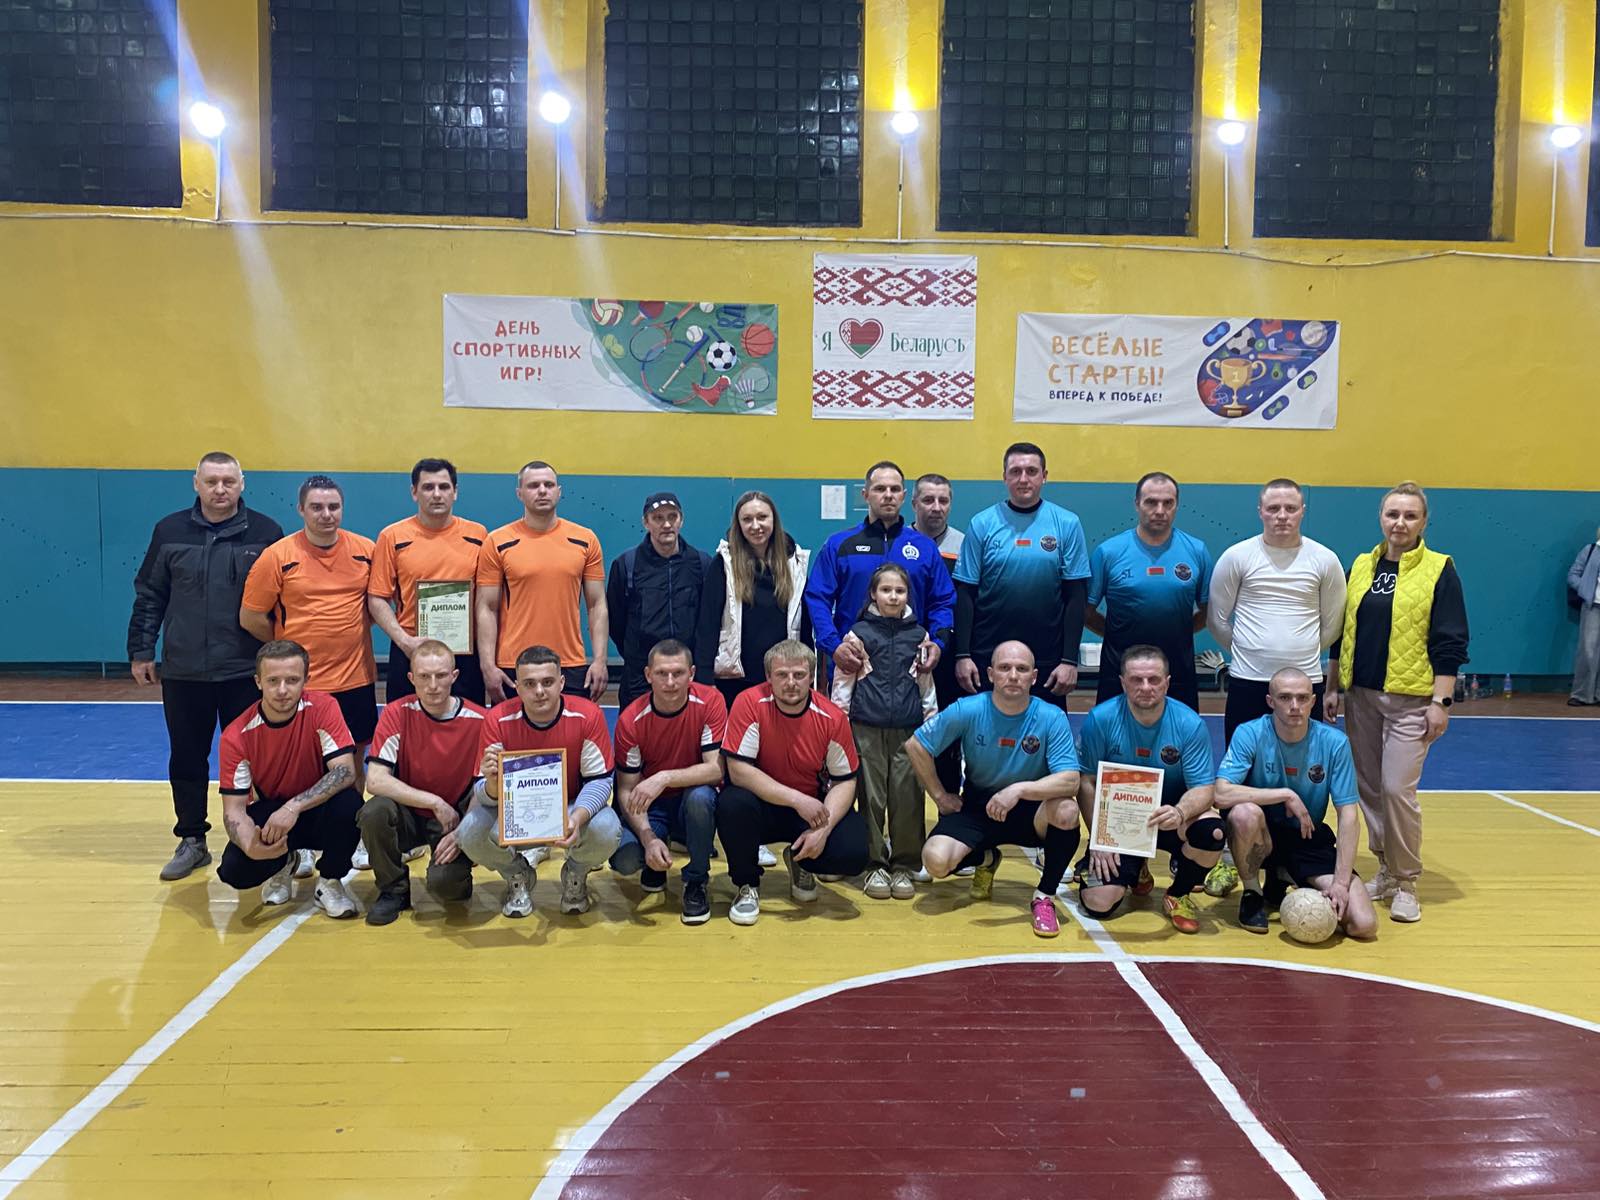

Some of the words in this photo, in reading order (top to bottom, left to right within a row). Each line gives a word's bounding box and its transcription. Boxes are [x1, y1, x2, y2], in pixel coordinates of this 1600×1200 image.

[495, 320, 540, 337] ДЕНЬ
[453, 342, 581, 359] СПОРТИВНЫХ
[822, 331, 832, 351] Я
[890, 332, 966, 357] Беларусь
[1052, 331, 1163, 357] ВЕСЁЛЫЕ
[500, 366, 542, 381] ИГР!
[1048, 364, 1164, 386] СТАРТЫ!
[1049, 390, 1094, 402] ВПЕРЕД
[1099, 391, 1106, 401] К
[1111, 392, 1162, 404] ПОБЕДЕ!
[430, 604, 466, 612] ДИПЛОМ
[975, 734, 986, 746] SL
[1265, 762, 1276, 774] SL
[517, 778, 558, 789] ДИПЛОМ
[1113, 792, 1153, 804] ДИПЛОМ
